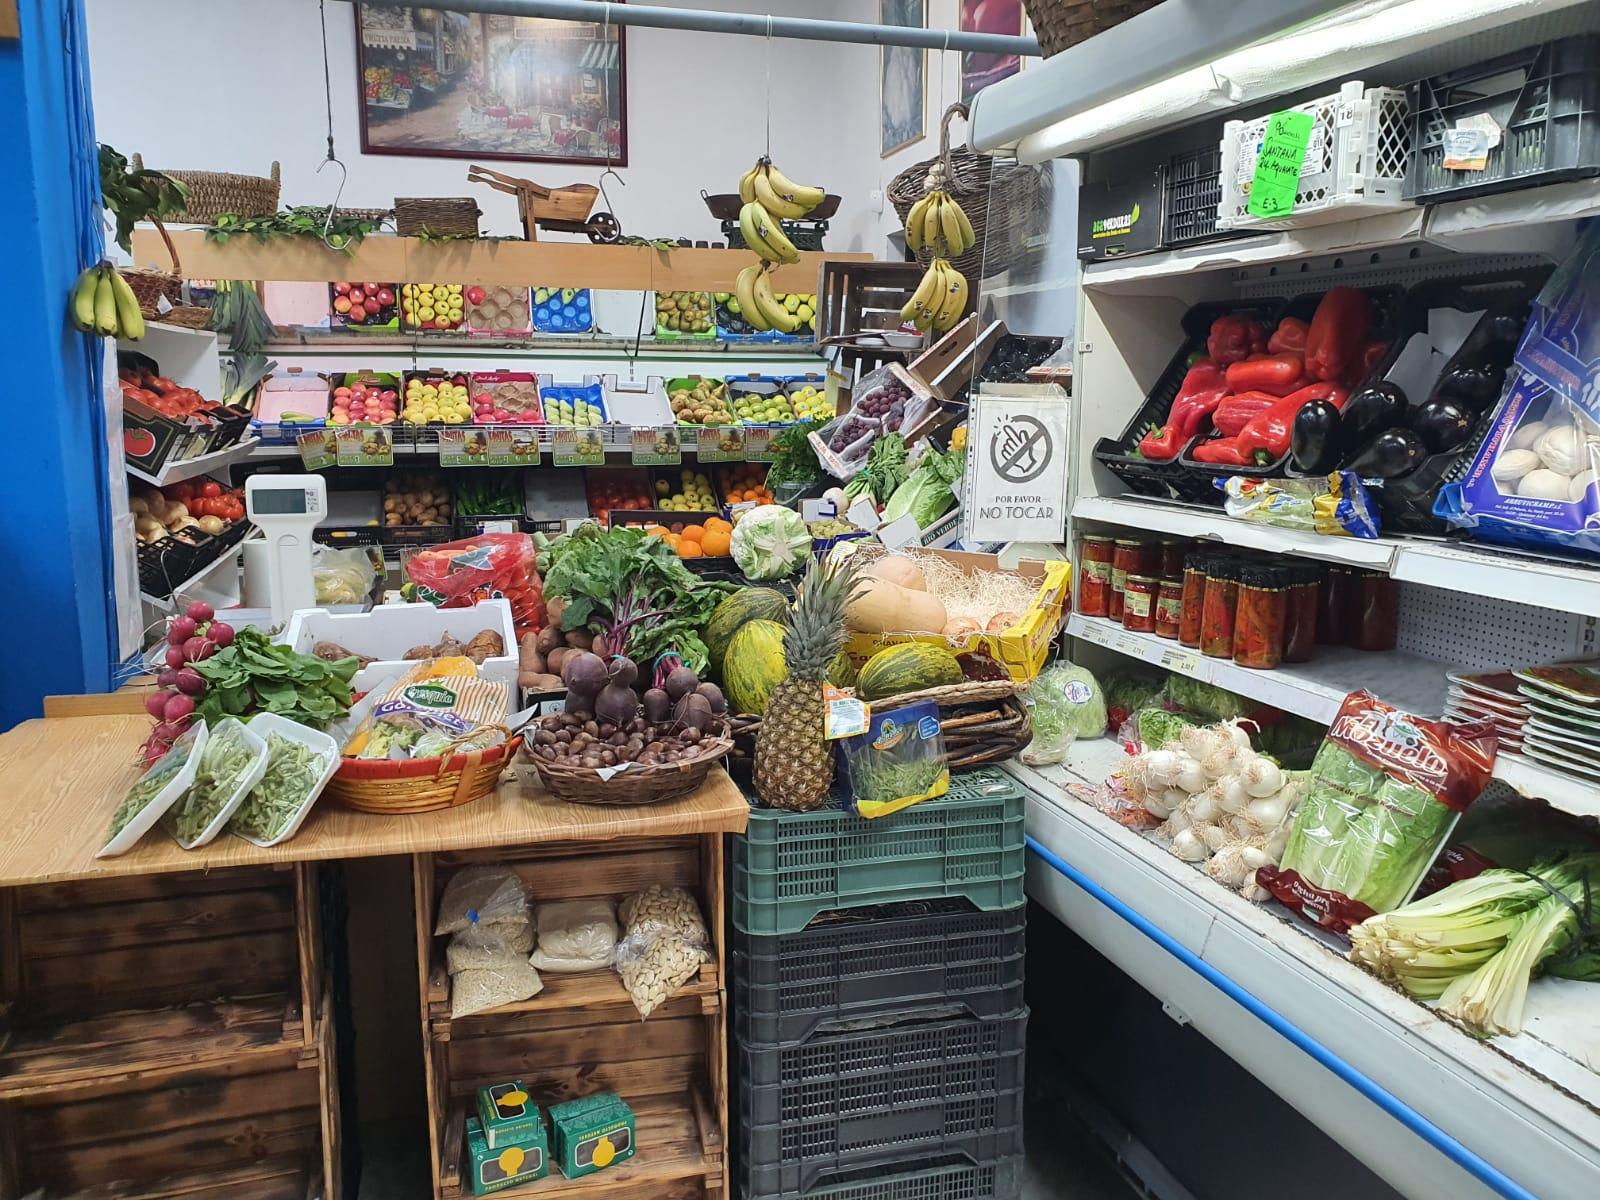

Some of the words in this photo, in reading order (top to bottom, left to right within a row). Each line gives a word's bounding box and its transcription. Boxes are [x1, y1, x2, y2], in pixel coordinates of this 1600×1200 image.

[995, 495, 1012, 503] POR
[1014, 495, 1042, 503] FAVOR
[979, 506, 1002, 519] NO
[1006, 506, 1054, 519] TOCAR
[1331, 715, 1448, 777] Mozuelo
